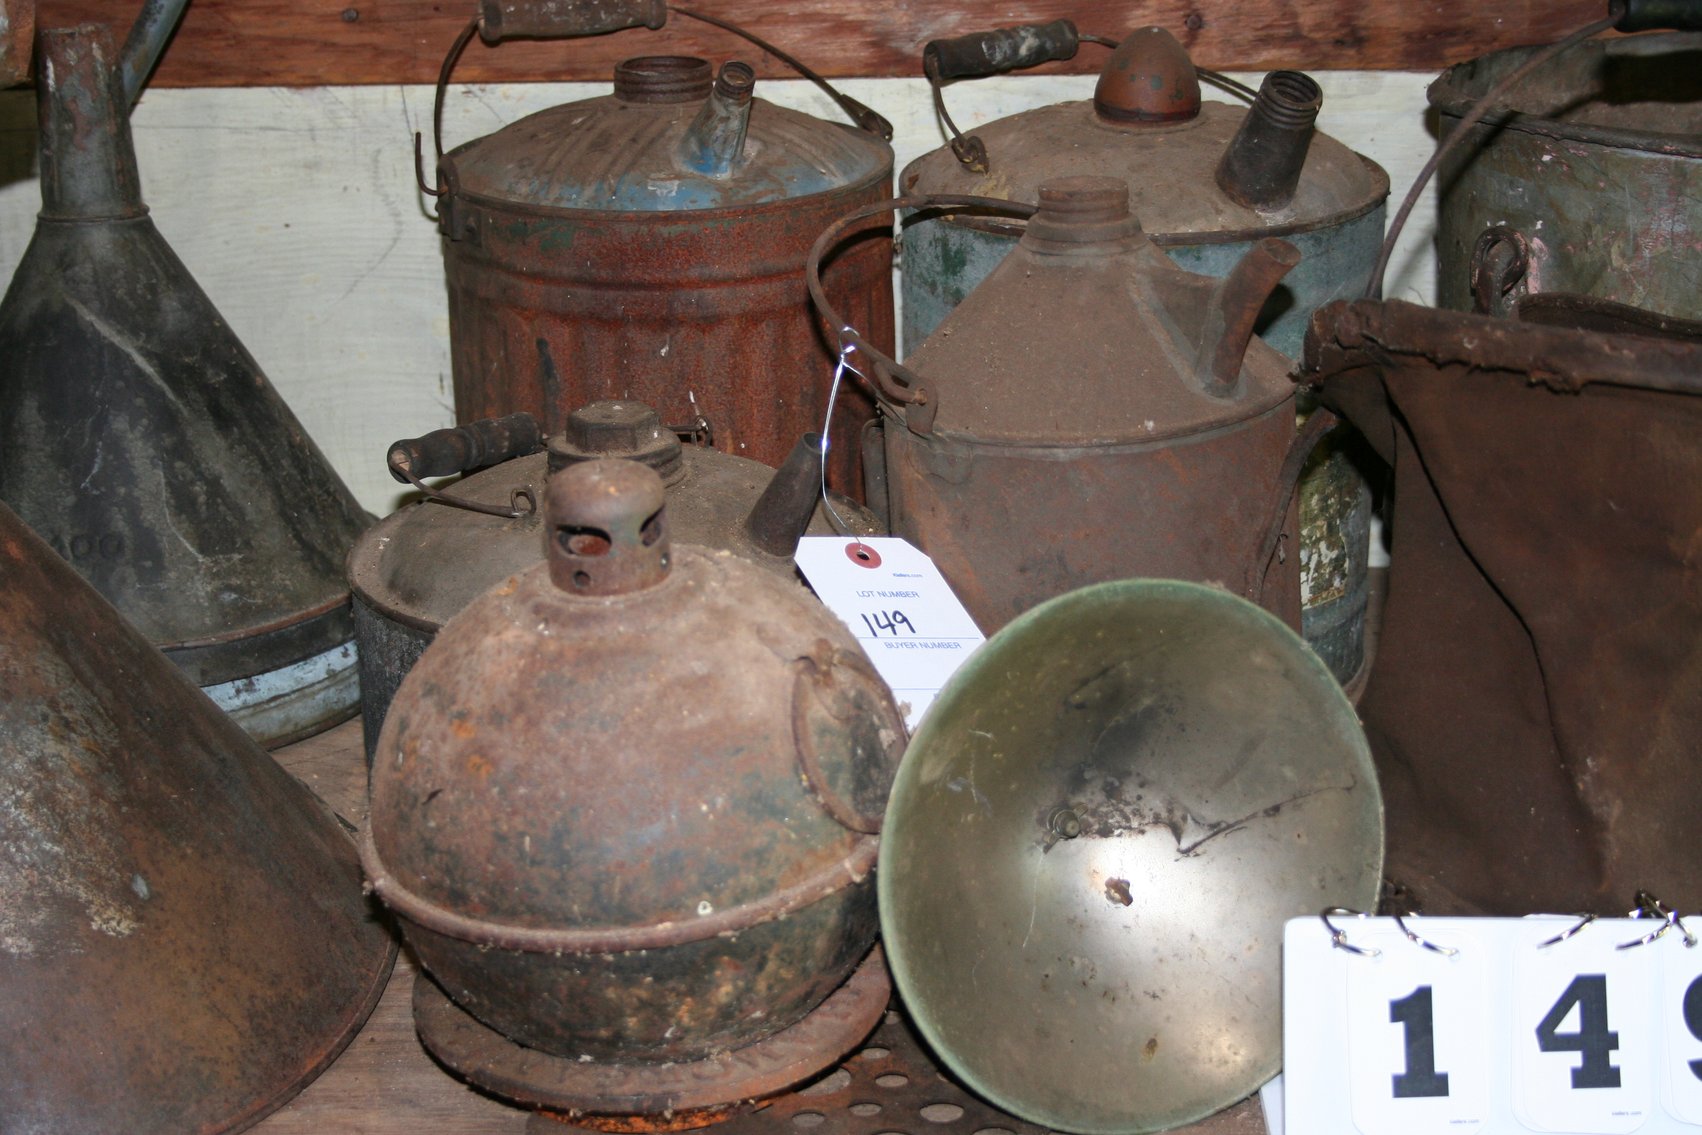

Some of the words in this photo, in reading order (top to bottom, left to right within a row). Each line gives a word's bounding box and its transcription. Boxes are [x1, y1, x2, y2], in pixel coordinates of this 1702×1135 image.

[856, 590, 875, 598] LOT
[877, 590, 920, 598] NUMBER
[861, 609, 916, 637] 149
[884, 641, 918, 649] BUYER
[919, 641, 962, 649] NUMBER
